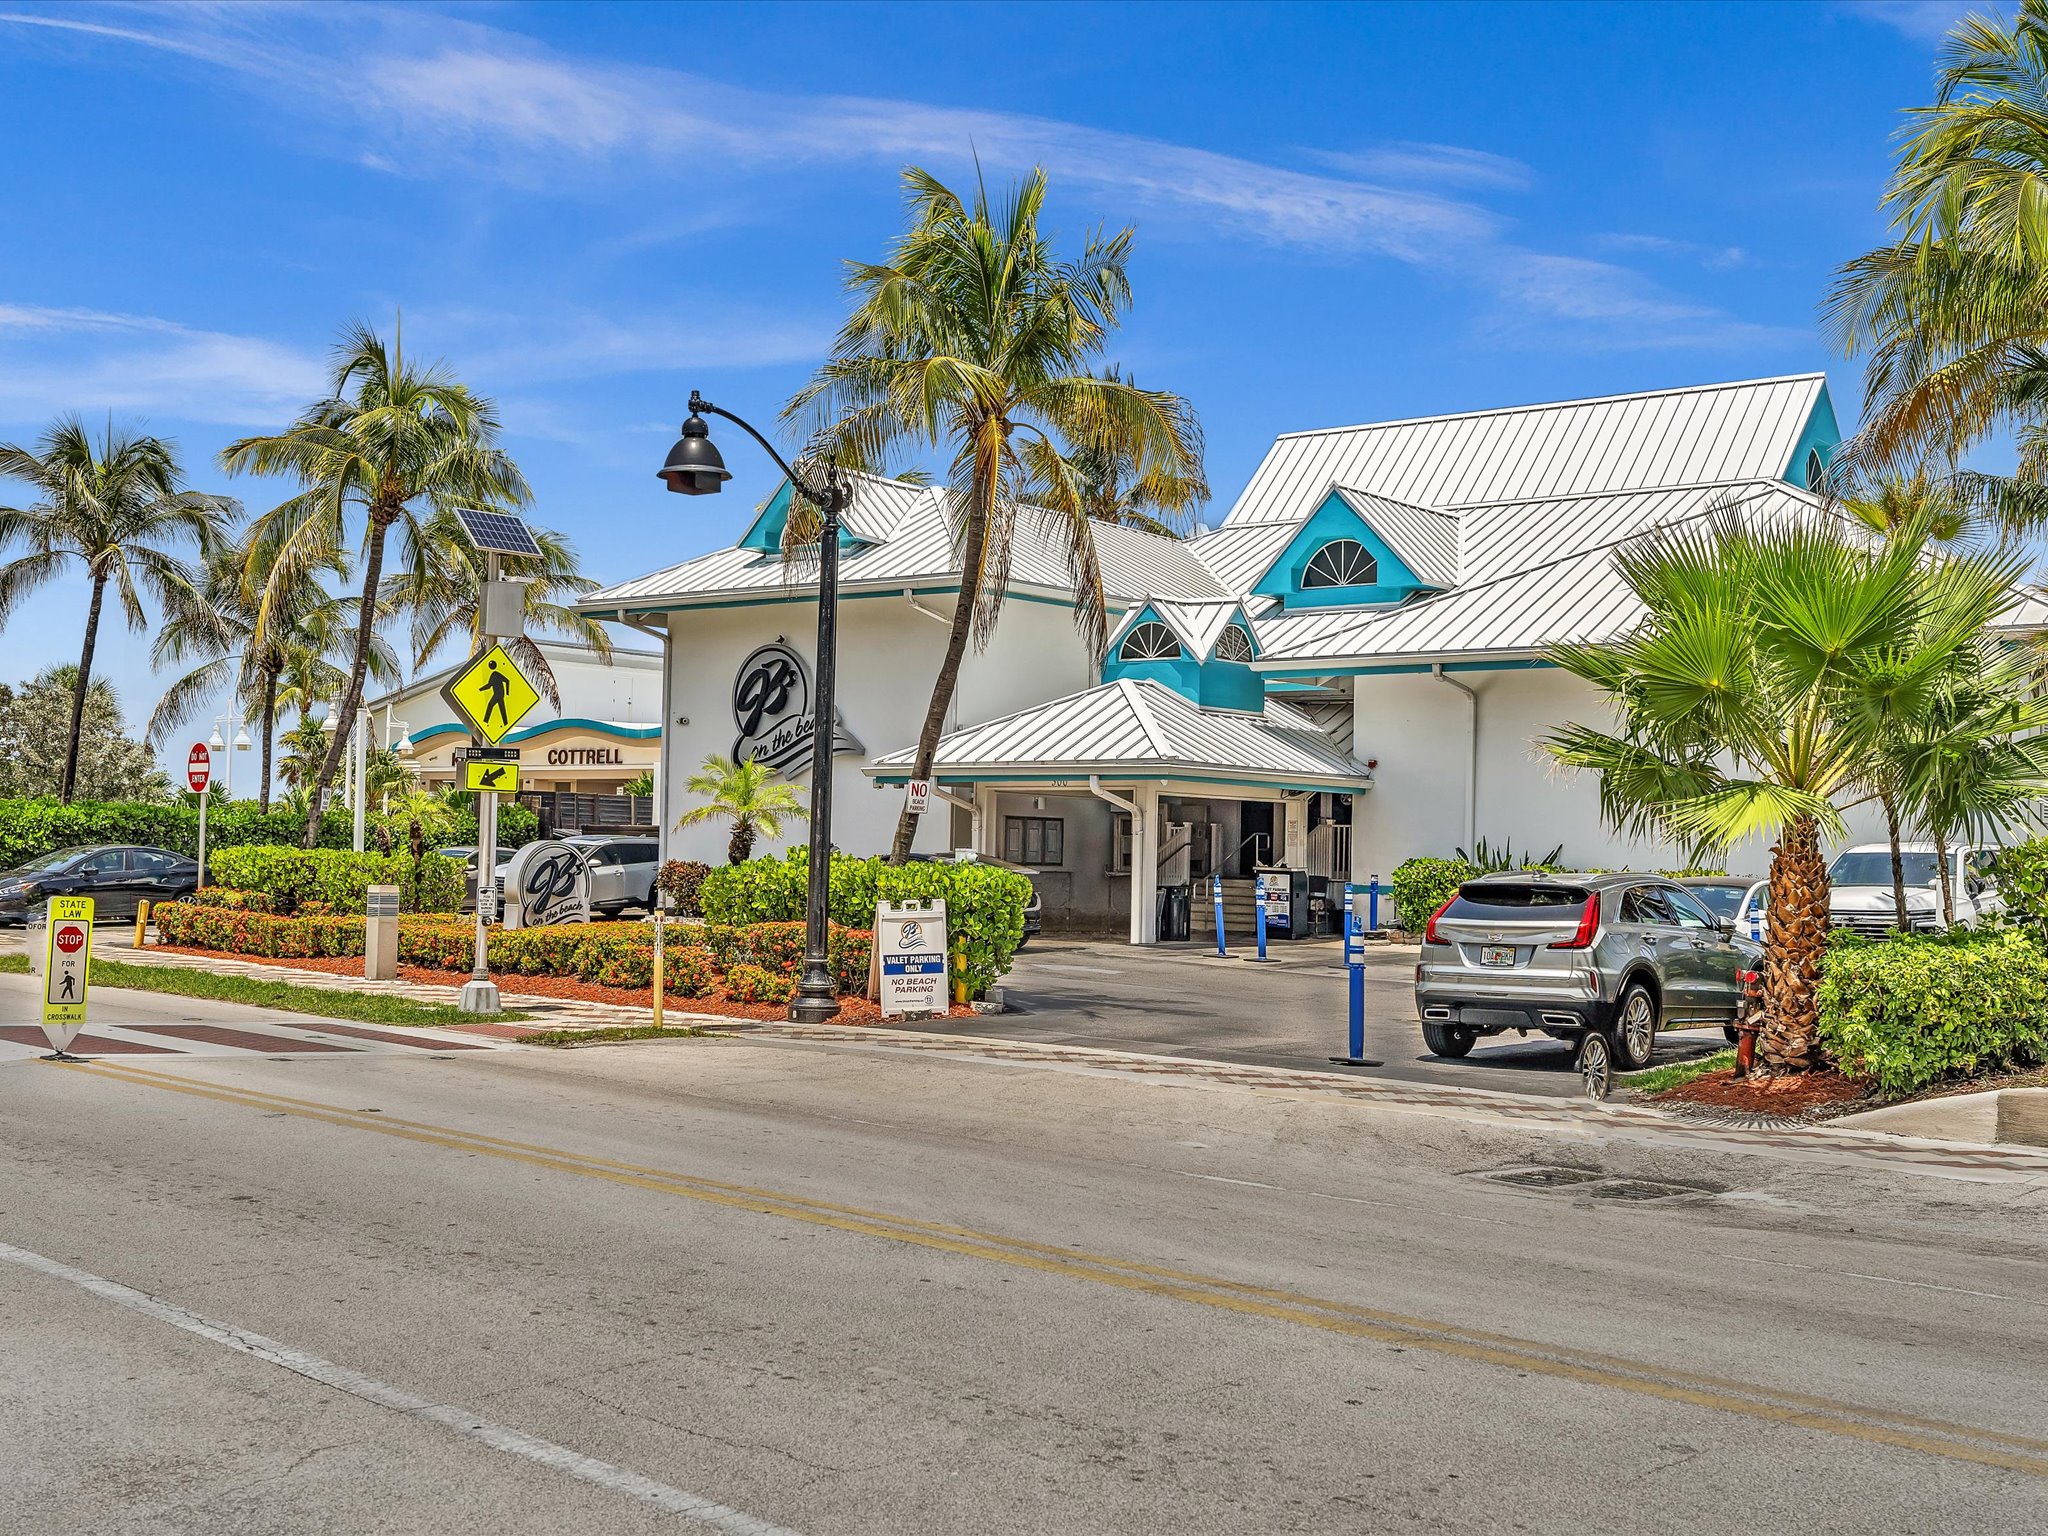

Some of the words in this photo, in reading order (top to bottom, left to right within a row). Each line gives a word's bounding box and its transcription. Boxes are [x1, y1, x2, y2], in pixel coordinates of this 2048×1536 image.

[772, 729, 793, 752] the
[191, 752, 197, 760] DO
[199, 752, 207, 760] NOT
[548, 749, 623, 764] COTTRELL
[191, 774, 206, 783] ENTER
[911, 783, 927, 797] NO
[60, 900, 86, 908] STATE
[546, 910, 558, 922] the
[560, 900, 584, 914] beach
[58, 934, 82, 944] STOP
[886, 956, 909, 965] VALET
[911, 954, 941, 964] PARKING
[905, 964, 922, 973] ONLY
